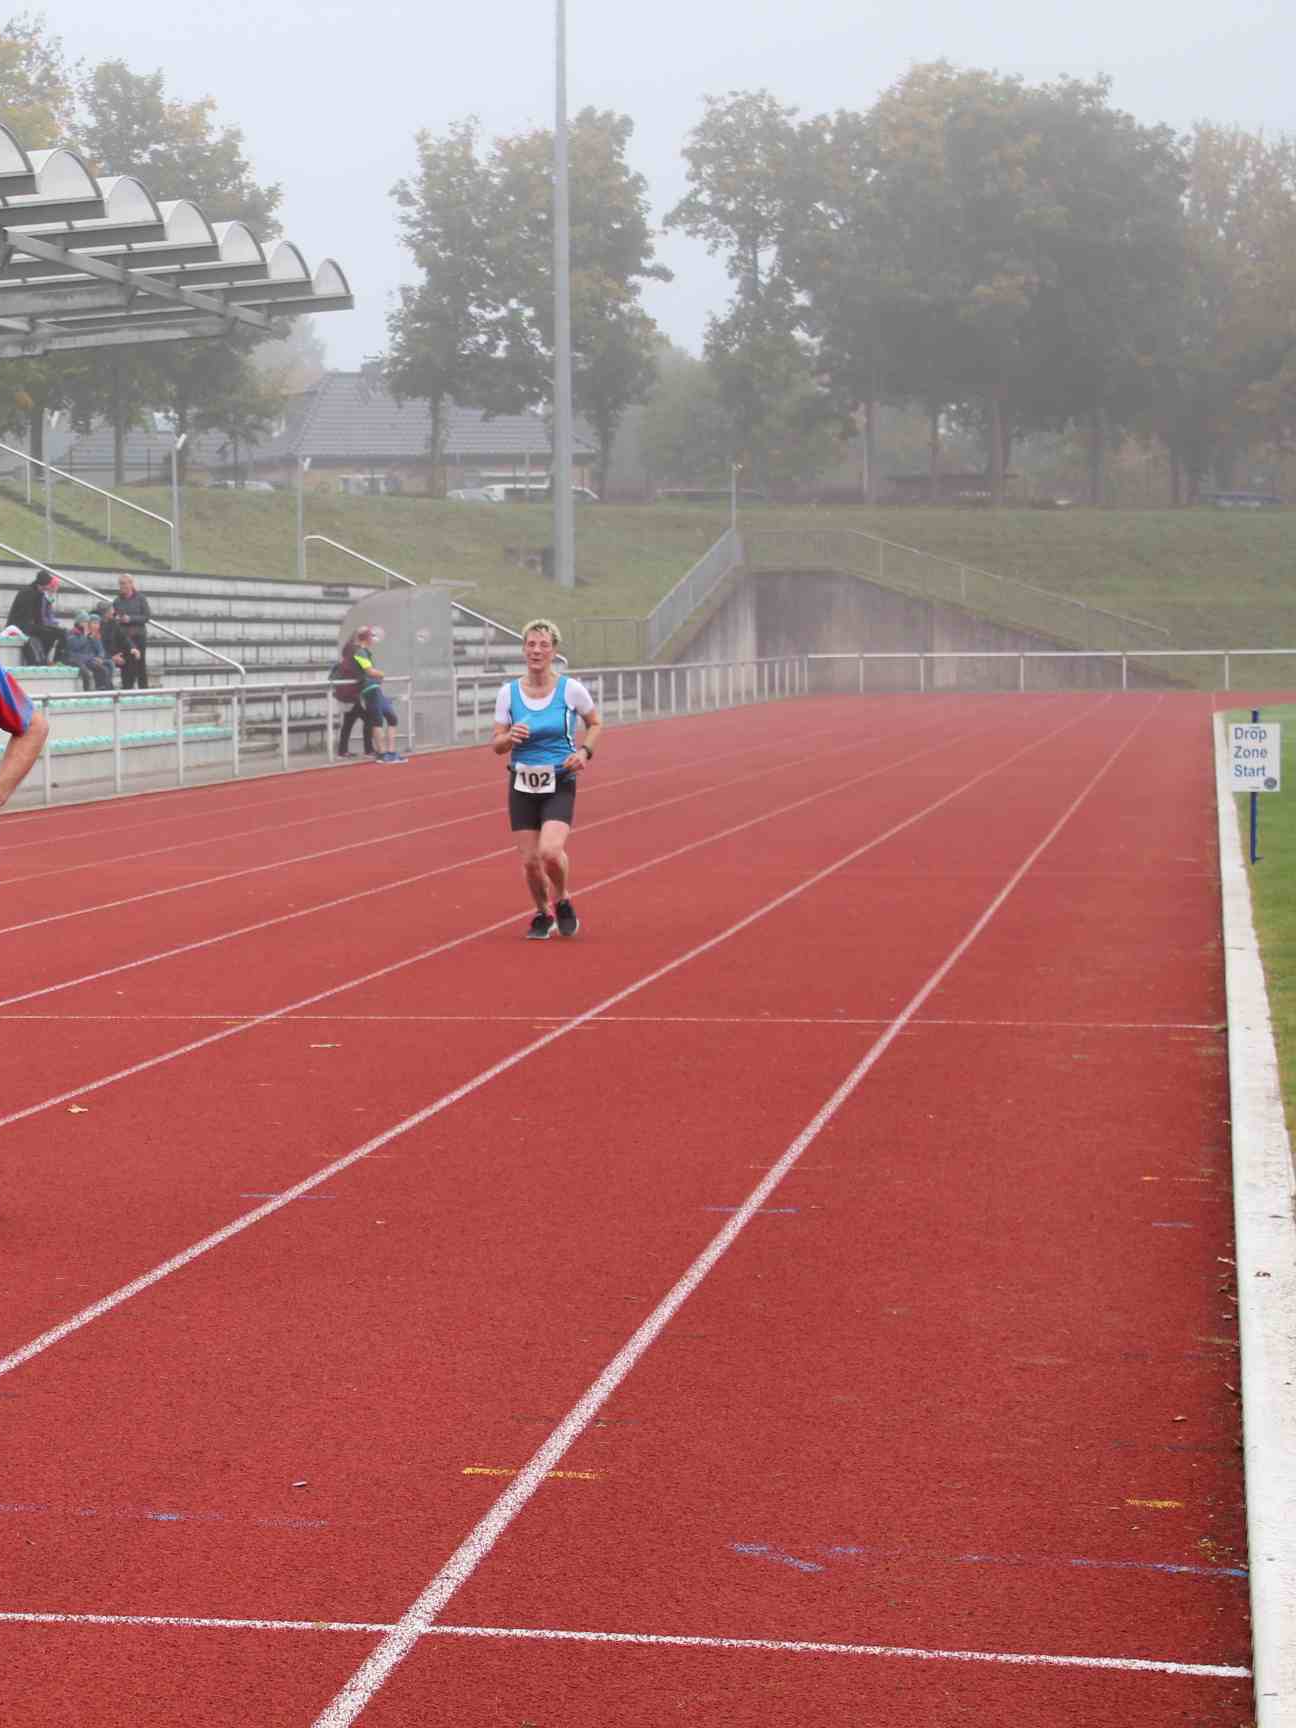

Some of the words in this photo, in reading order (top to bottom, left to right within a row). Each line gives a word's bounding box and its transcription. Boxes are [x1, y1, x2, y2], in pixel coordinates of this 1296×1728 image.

[1234, 727, 1267, 742] Drop
[1234, 745, 1268, 758] Zone
[1234, 764, 1265, 777] Start
[519, 772, 550, 788] 102
